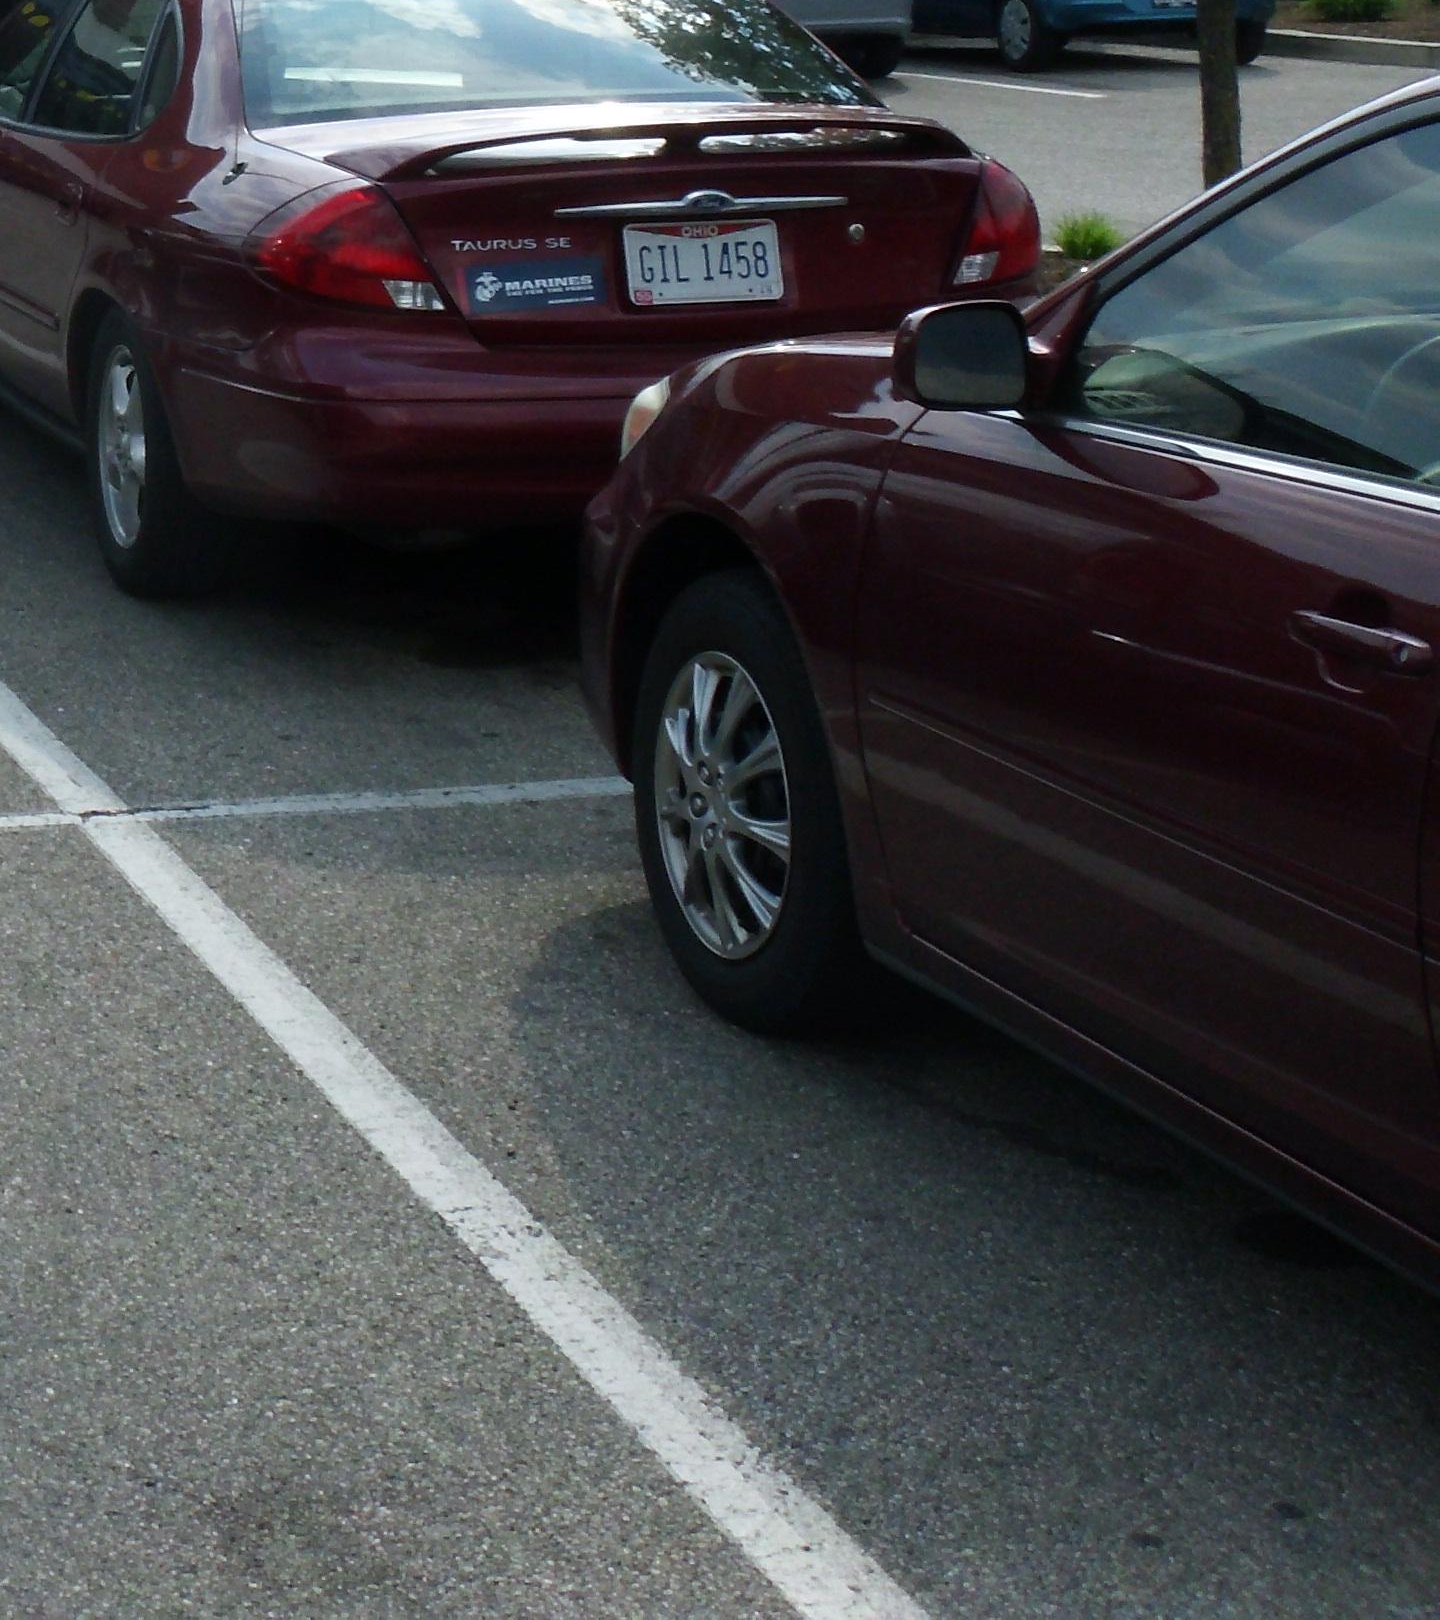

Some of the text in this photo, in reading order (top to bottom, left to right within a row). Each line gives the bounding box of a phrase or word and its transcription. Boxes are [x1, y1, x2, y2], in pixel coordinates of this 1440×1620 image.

[681, 225, 719, 238] OHIO
[450, 237, 573, 252] TAURUS SE
[638, 241, 770, 284] GIL 1458
[504, 275, 593, 292] MARINES
